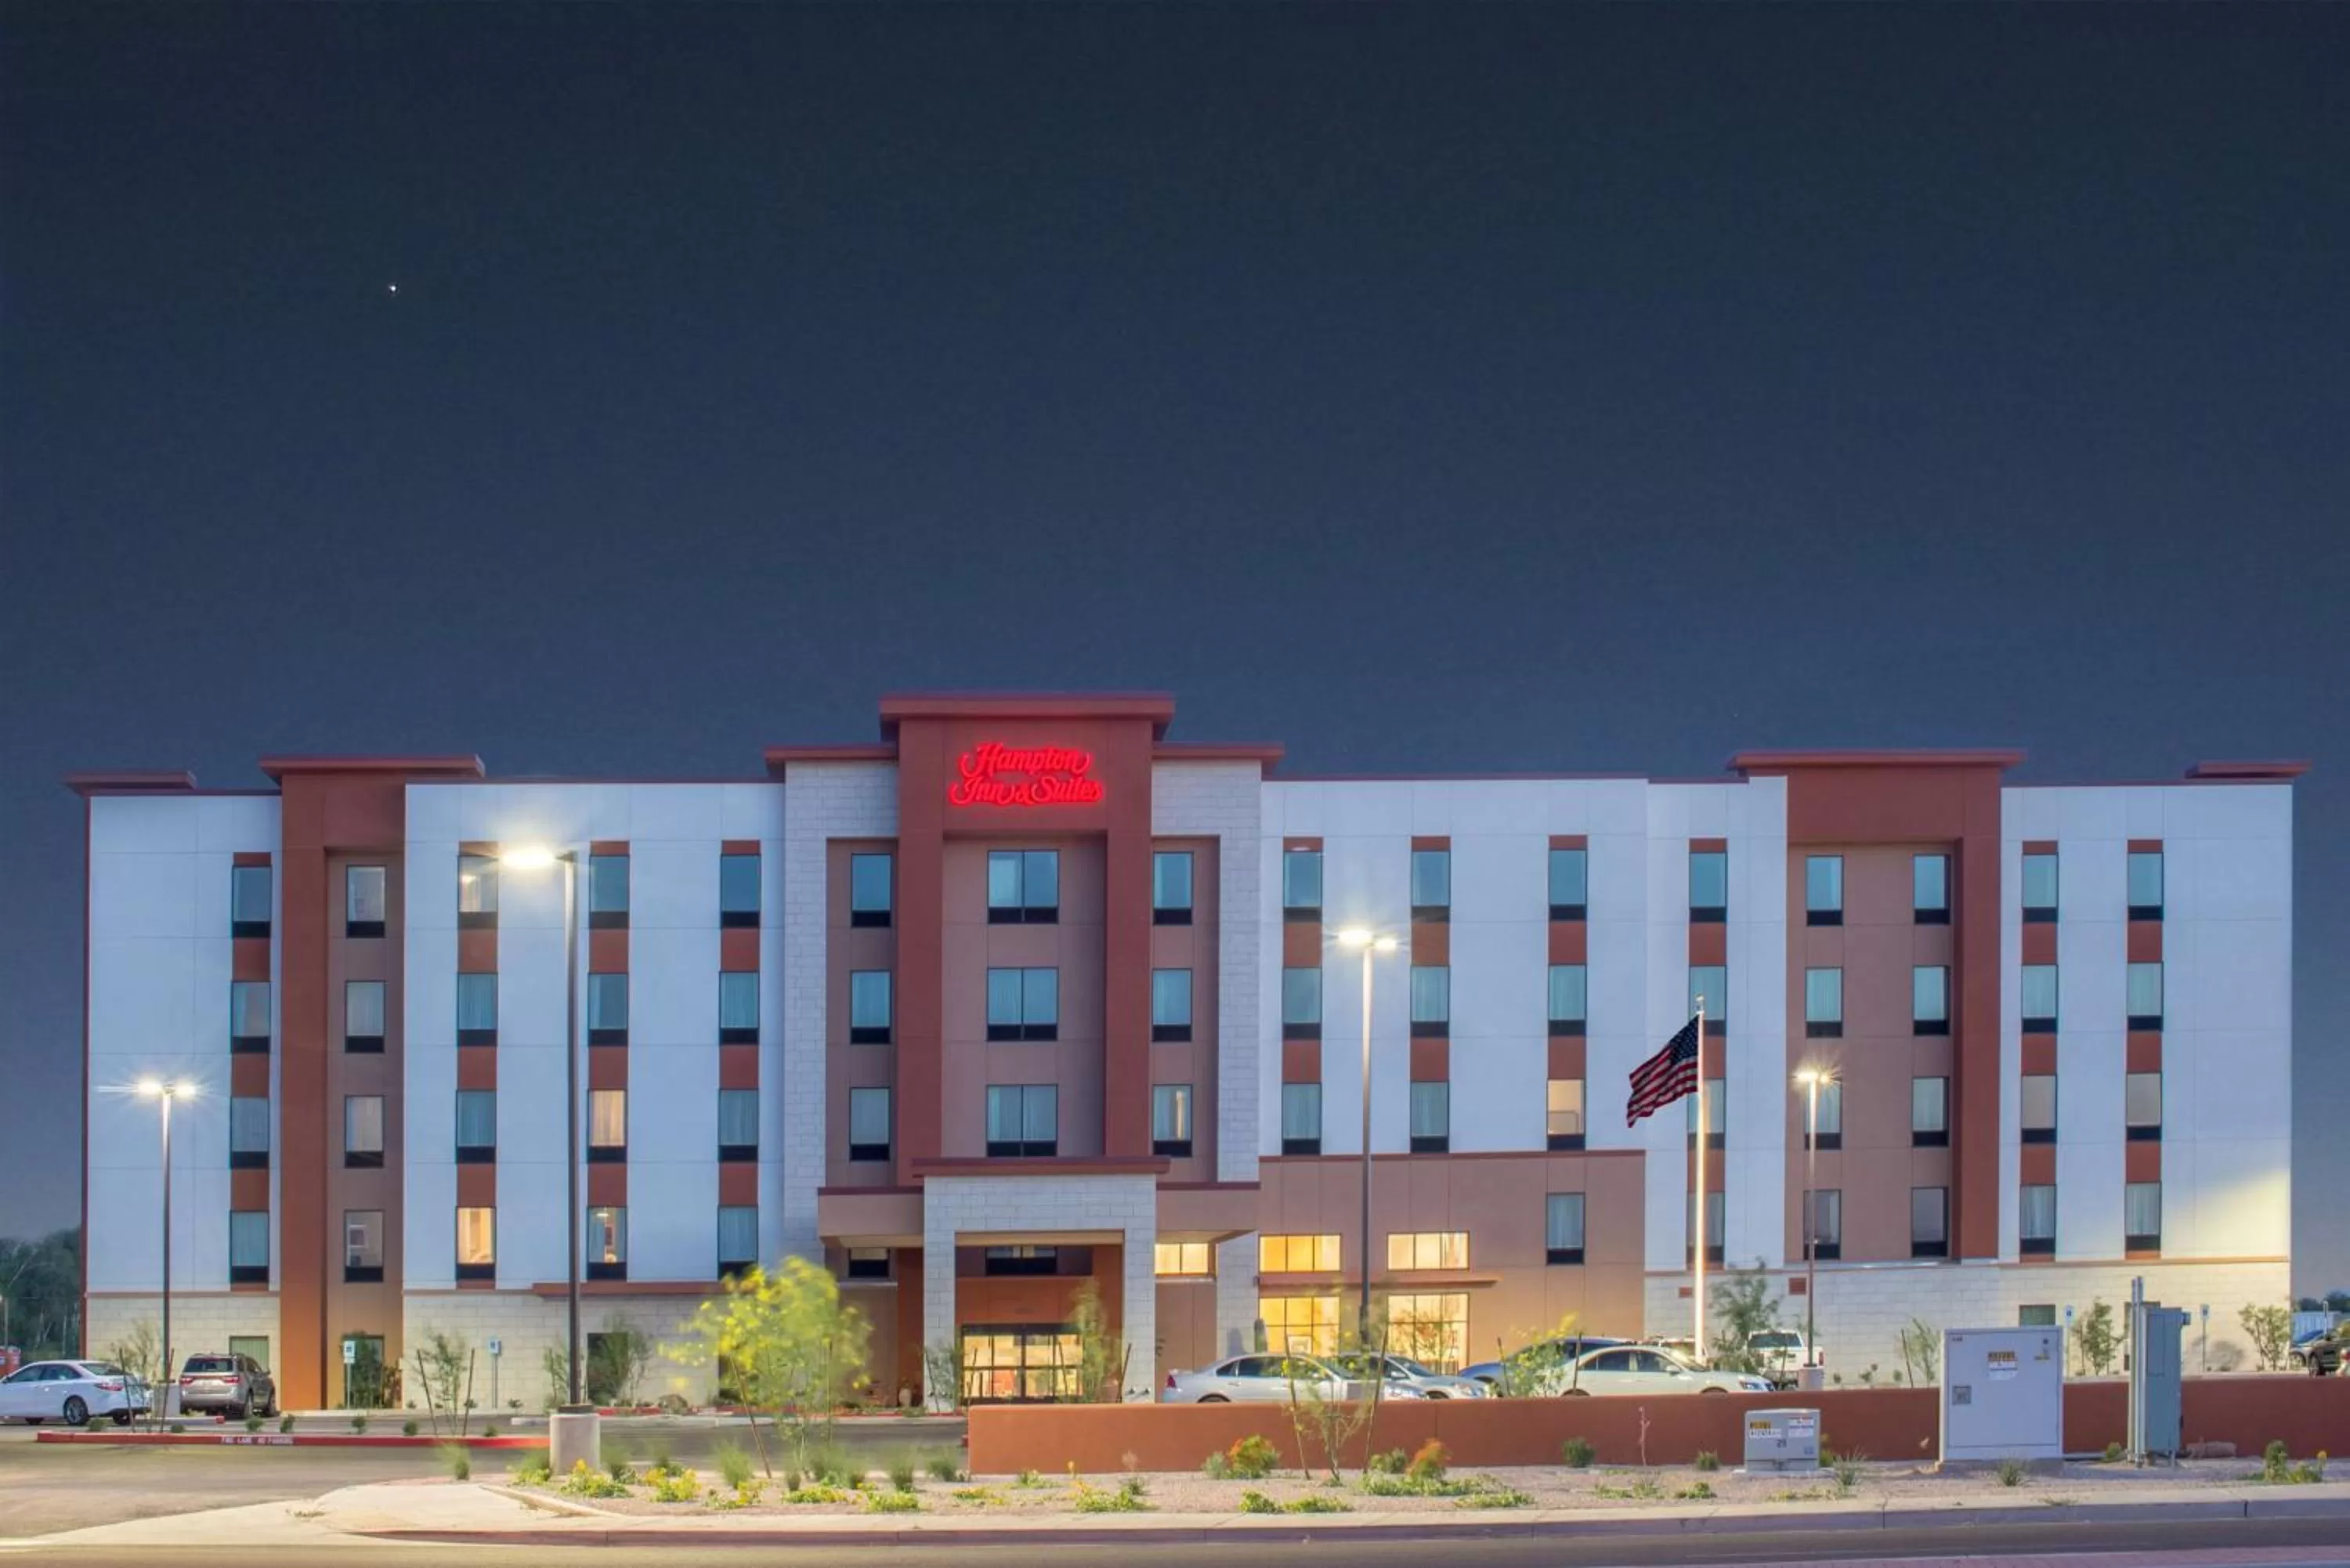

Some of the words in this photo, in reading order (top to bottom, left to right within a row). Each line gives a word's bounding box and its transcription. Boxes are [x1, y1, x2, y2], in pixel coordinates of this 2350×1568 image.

[958, 742, 1093, 778] Hampton
[949, 775, 1016, 805] Inn
[1031, 775, 1104, 804] Suites
